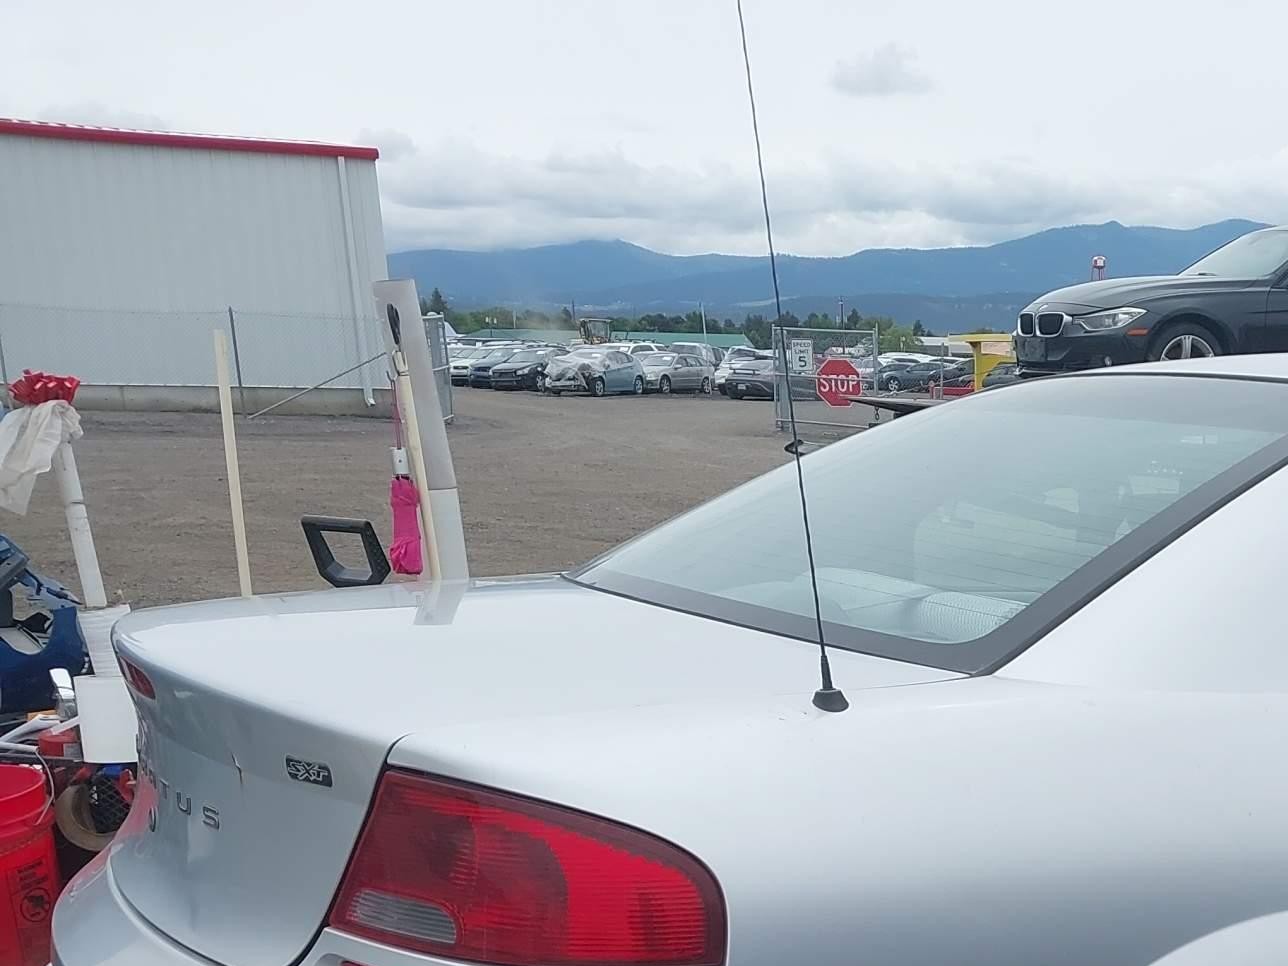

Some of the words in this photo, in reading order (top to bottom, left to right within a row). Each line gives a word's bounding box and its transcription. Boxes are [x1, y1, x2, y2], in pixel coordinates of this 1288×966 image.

[798, 355, 807, 368] 5
[820, 374, 859, 393] STOP
[286, 760, 330, 782] SXT
